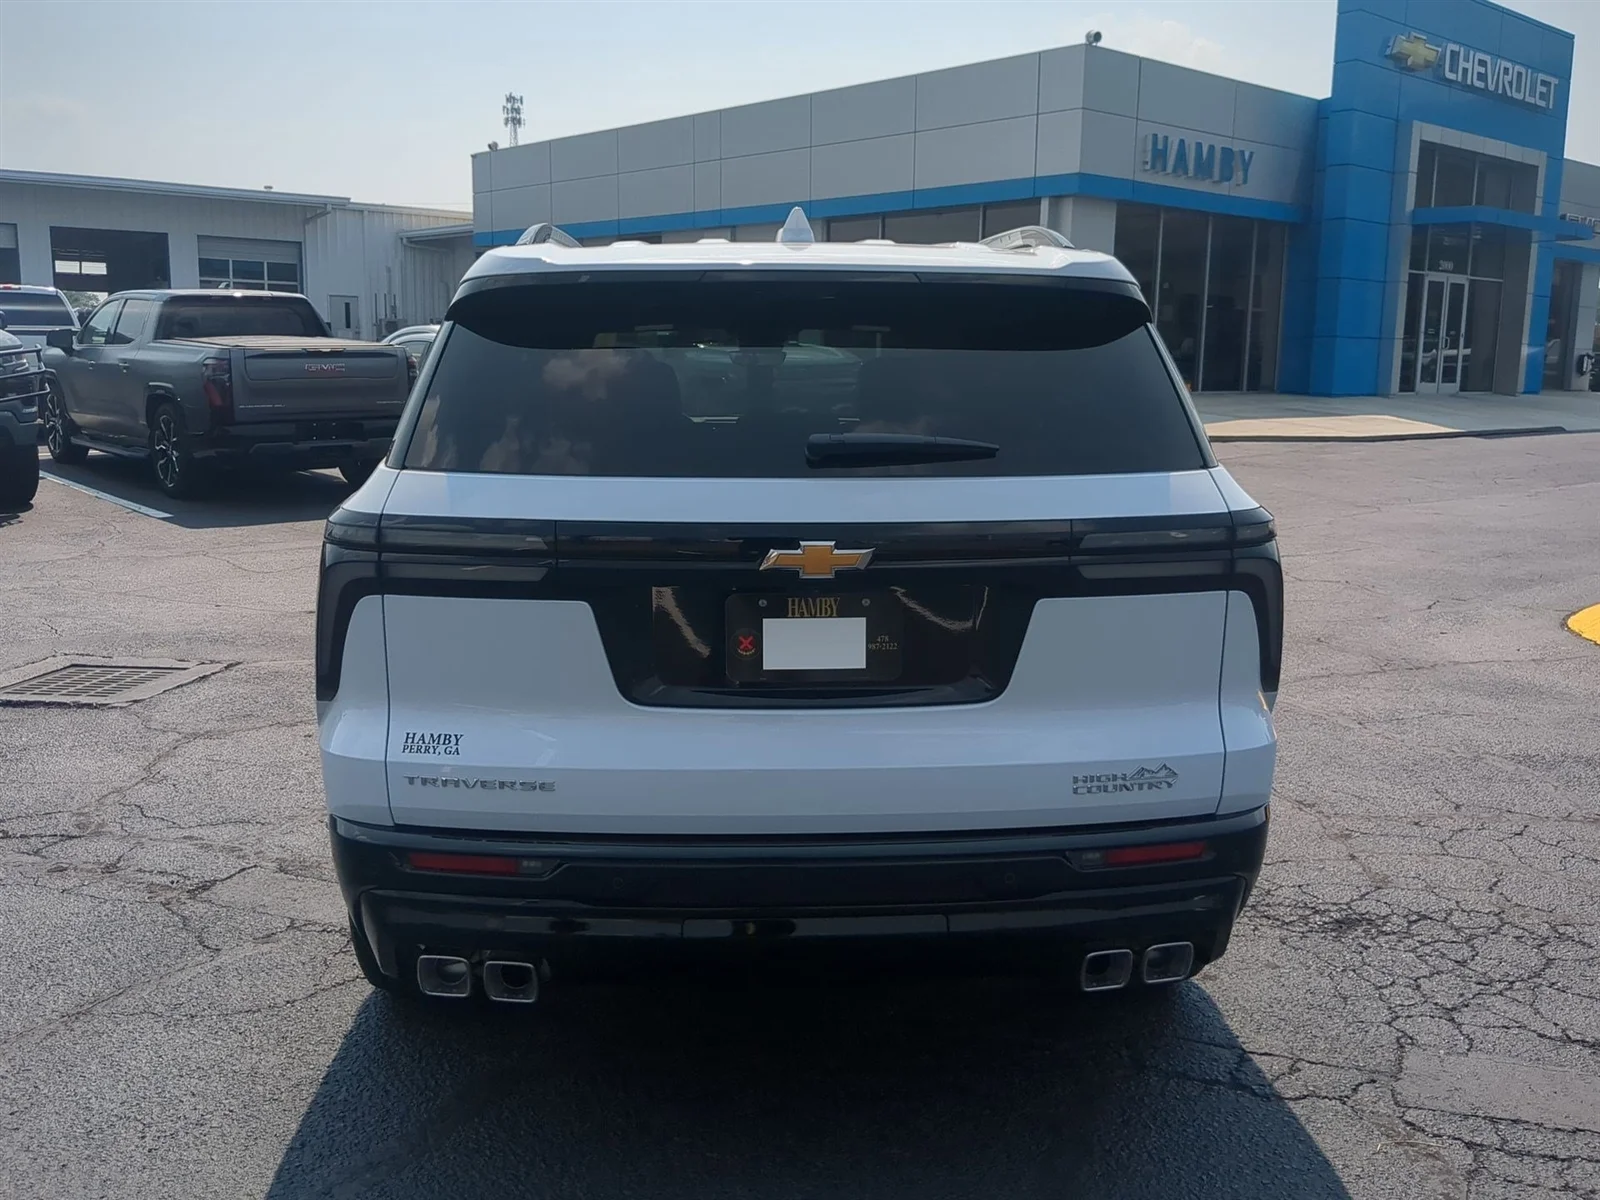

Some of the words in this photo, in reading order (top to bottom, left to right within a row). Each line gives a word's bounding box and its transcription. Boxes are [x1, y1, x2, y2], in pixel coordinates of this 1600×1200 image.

[1444, 42, 1559, 109] CHEVROLET
[1146, 133, 1255, 186] HAMBY
[304, 362, 346, 372] GMC
[787, 597, 840, 618] HAMBY
[877, 634, 889, 643] 478
[404, 732, 464, 746] HAMBY
[401, 744, 442, 757] PERRY,
[443, 746, 461, 756] GA
[403, 774, 557, 792] TRAVERSE
[1072, 773, 1128, 784] HIGH
[1072, 780, 1177, 795] COUNTRY
